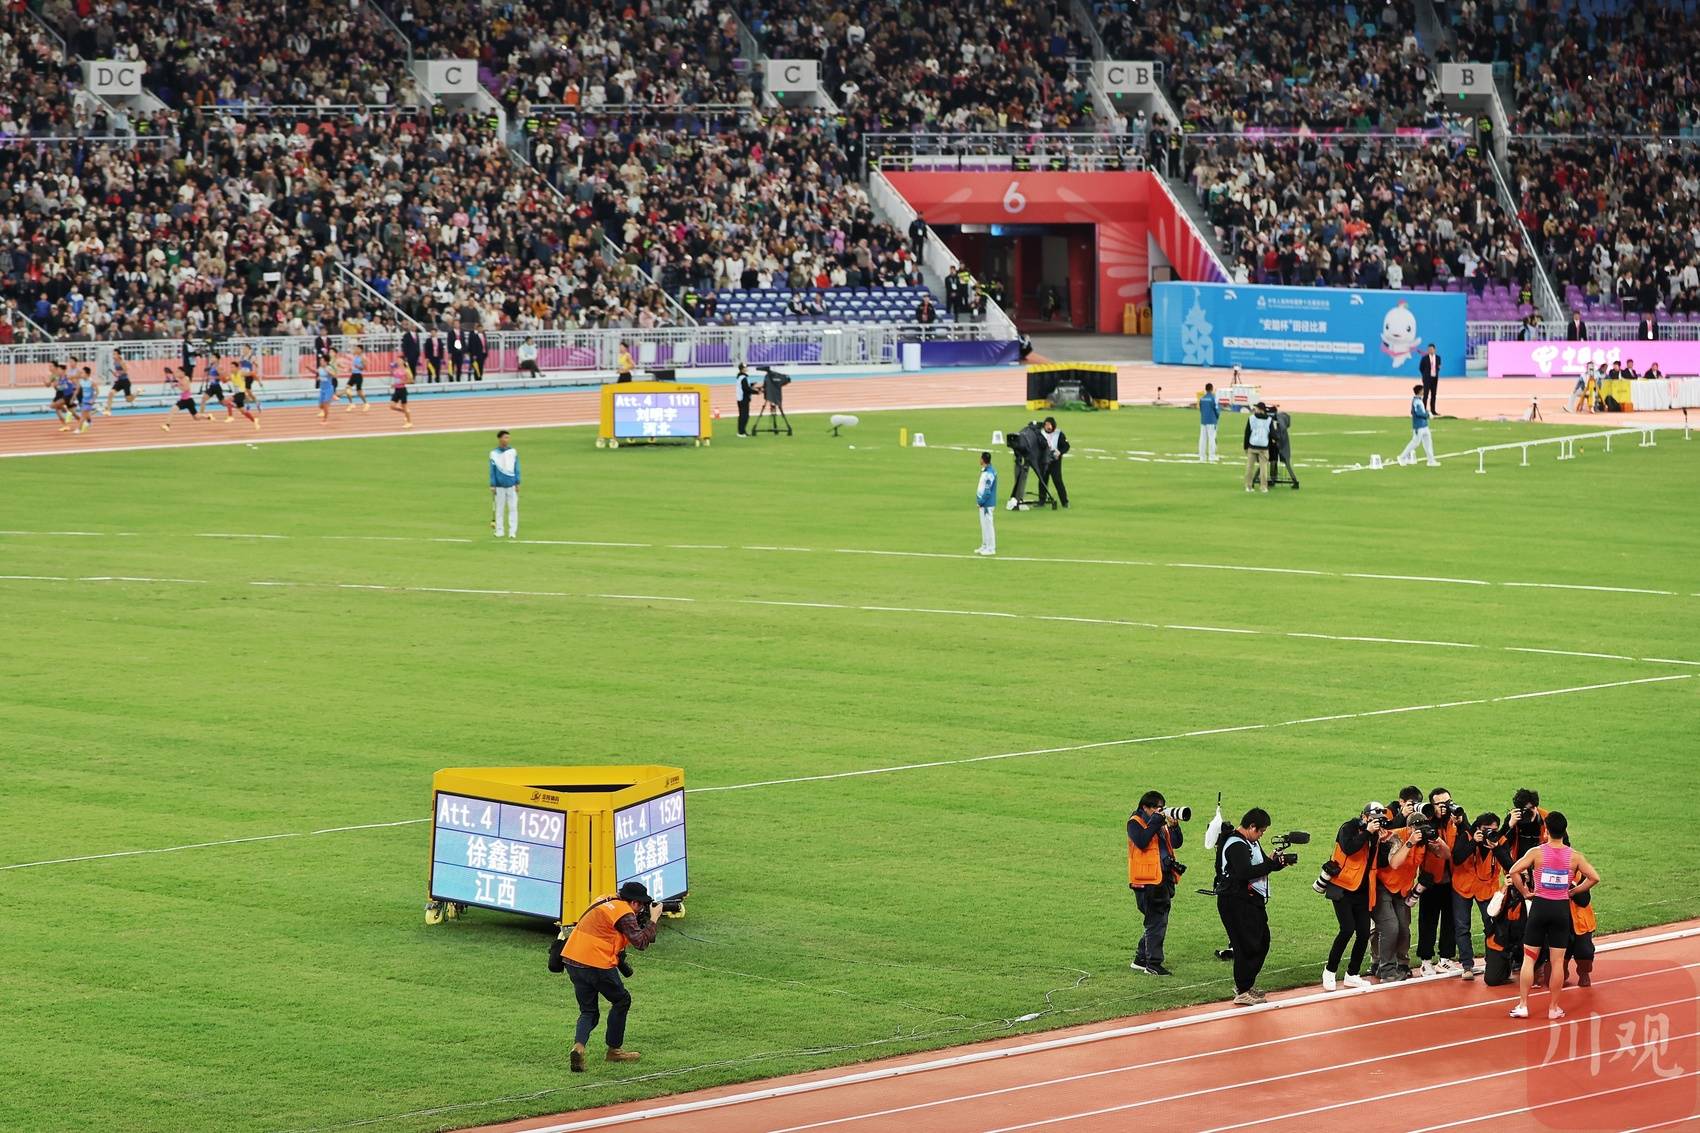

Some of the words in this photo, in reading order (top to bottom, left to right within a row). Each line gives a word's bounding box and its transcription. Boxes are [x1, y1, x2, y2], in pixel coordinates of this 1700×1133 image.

[445, 66, 462, 85] C
[784, 65, 801, 84] C
[1461, 68, 1475, 86] B
[1003, 181, 1026, 214] 6
[616, 395, 641, 407] Att.
[643, 395, 653, 407] 4
[669, 395, 695, 407] 1101
[643, 422, 672, 436] 河北
[439, 798, 475, 828] Att.
[480, 805, 492, 830] 4
[519, 811, 561, 841] 1529
[616, 815, 638, 842] Att.
[639, 807, 647, 832] 4
[659, 795, 682, 825] 1529
[466, 836, 530, 876] 徐鑫颖
[634, 834, 668, 874] 徐鑫颖
[475, 871, 517, 907] 江西
